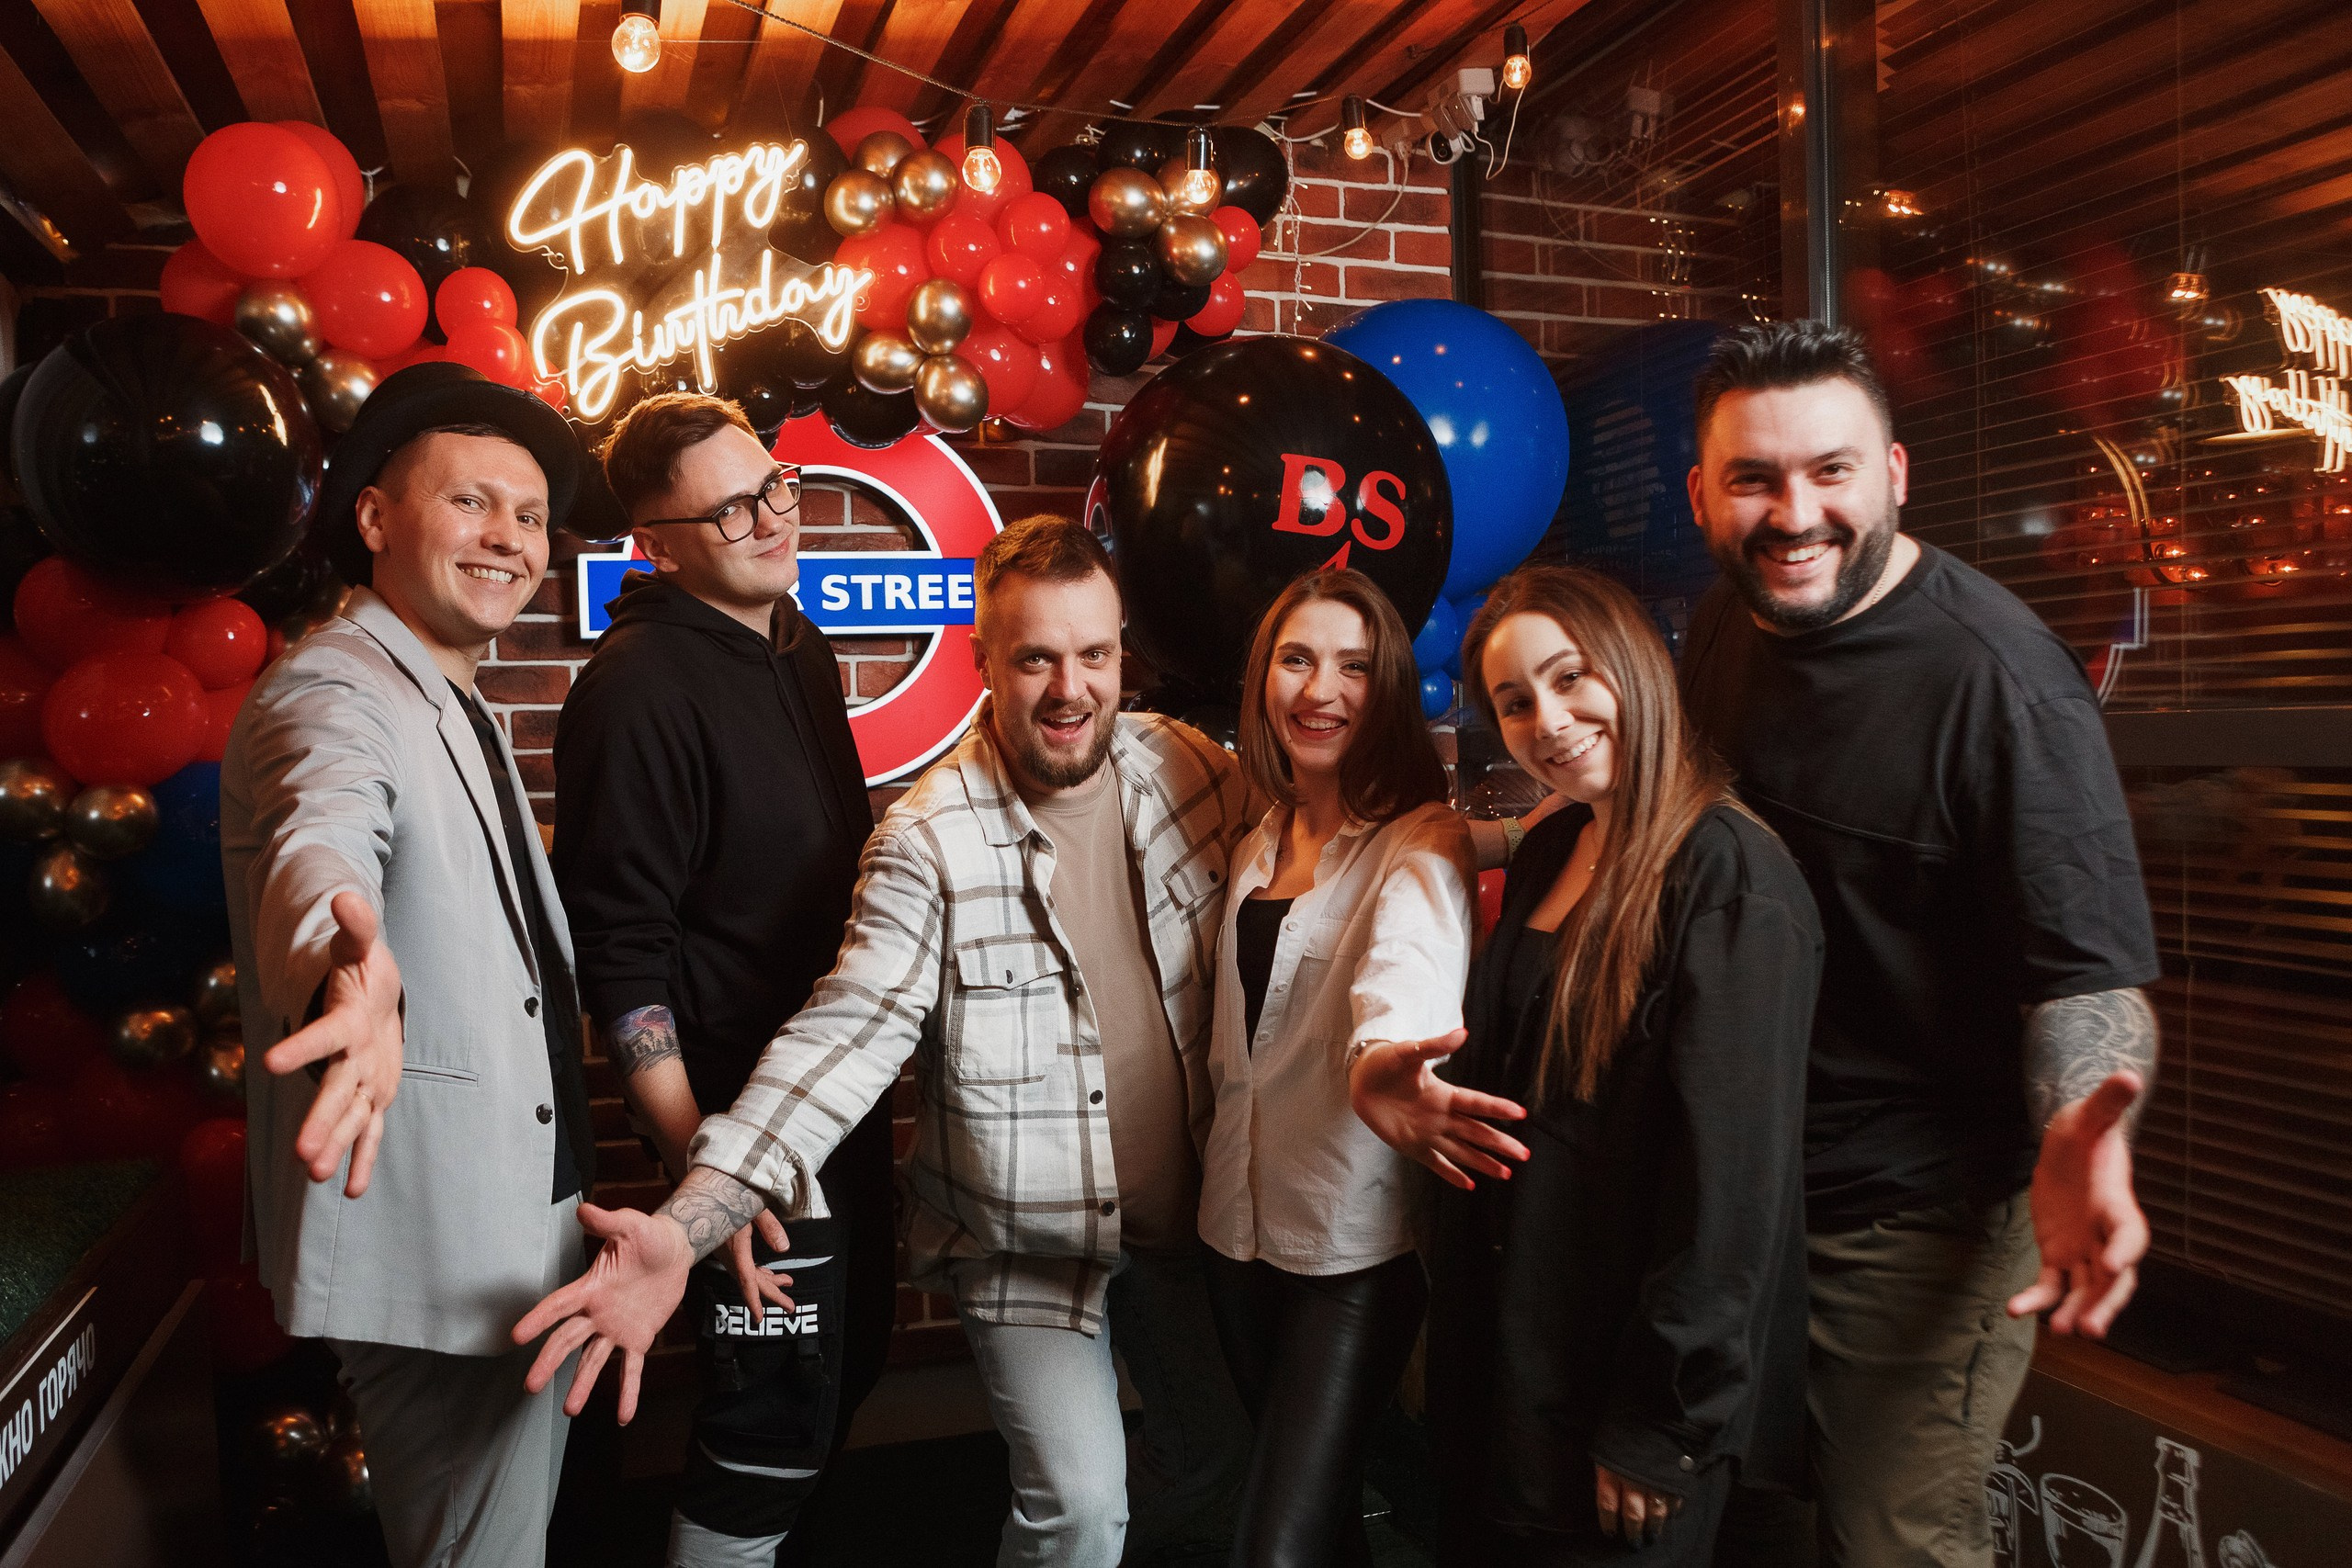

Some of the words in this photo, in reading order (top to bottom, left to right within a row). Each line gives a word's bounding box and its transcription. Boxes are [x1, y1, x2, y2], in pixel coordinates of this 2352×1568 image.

[508, 141, 807, 276] Happy
[533, 248, 876, 417] Birthday
[1272, 453, 1407, 550] BS
[820, 573, 975, 612] STREE
[715, 1303, 819, 1337] BELIEVE
[39, 1323, 96, 1435] ГОРЯЧО
